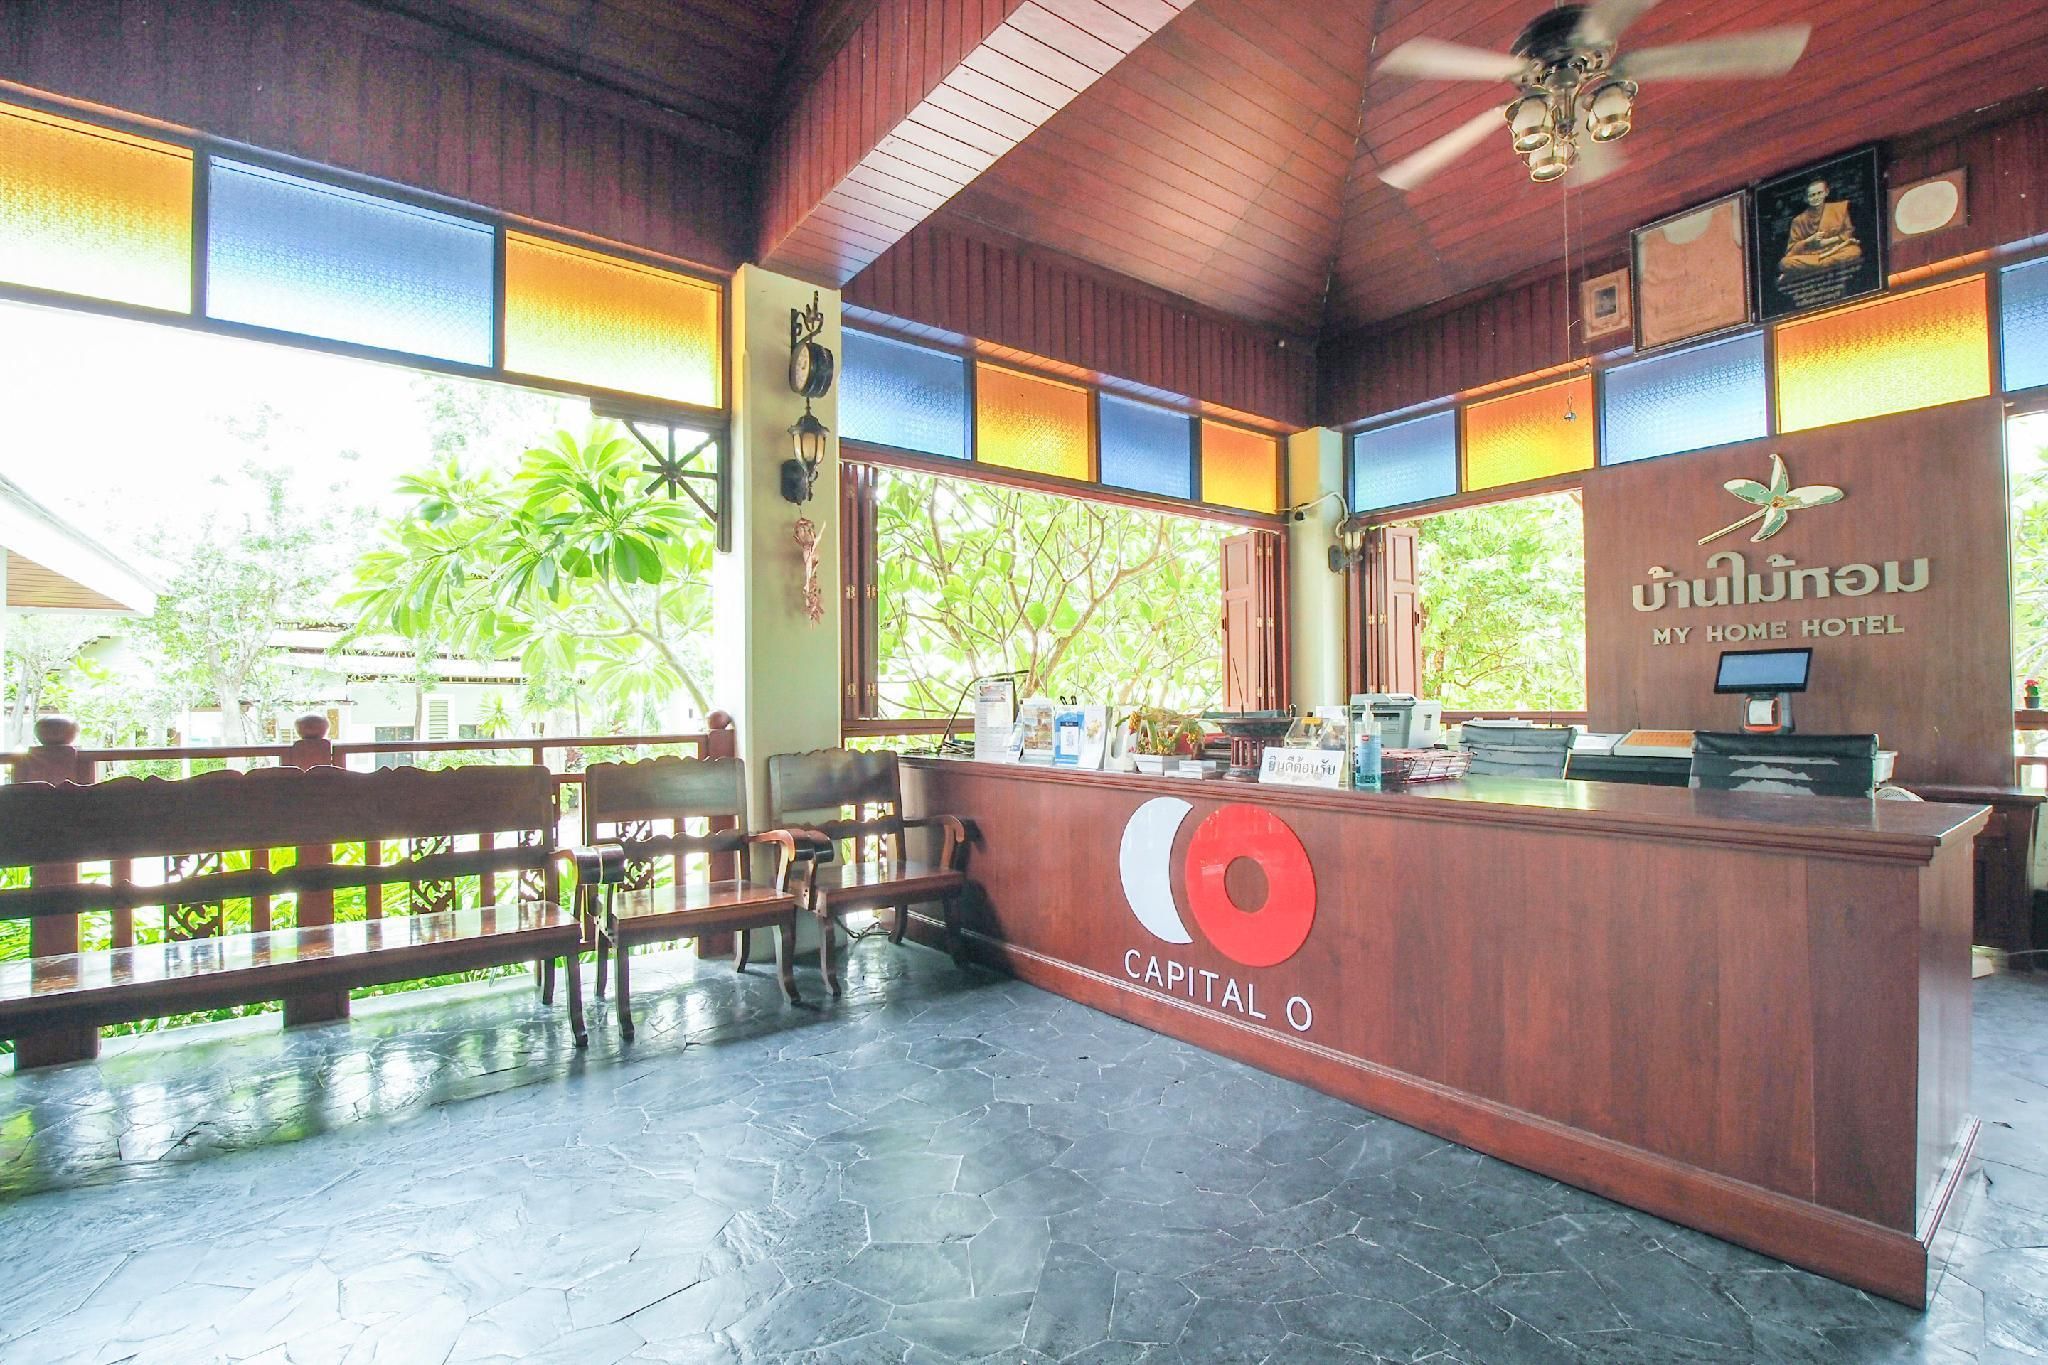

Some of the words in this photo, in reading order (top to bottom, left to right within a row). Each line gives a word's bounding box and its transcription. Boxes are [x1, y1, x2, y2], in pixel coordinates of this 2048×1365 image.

[1653, 627, 1692, 645] MY
[1706, 621, 1787, 642] HOME
[1802, 614, 1905, 638] HOTEL
[1124, 948, 1267, 1020] CAPITAL
[1286, 996, 1313, 1032] O
